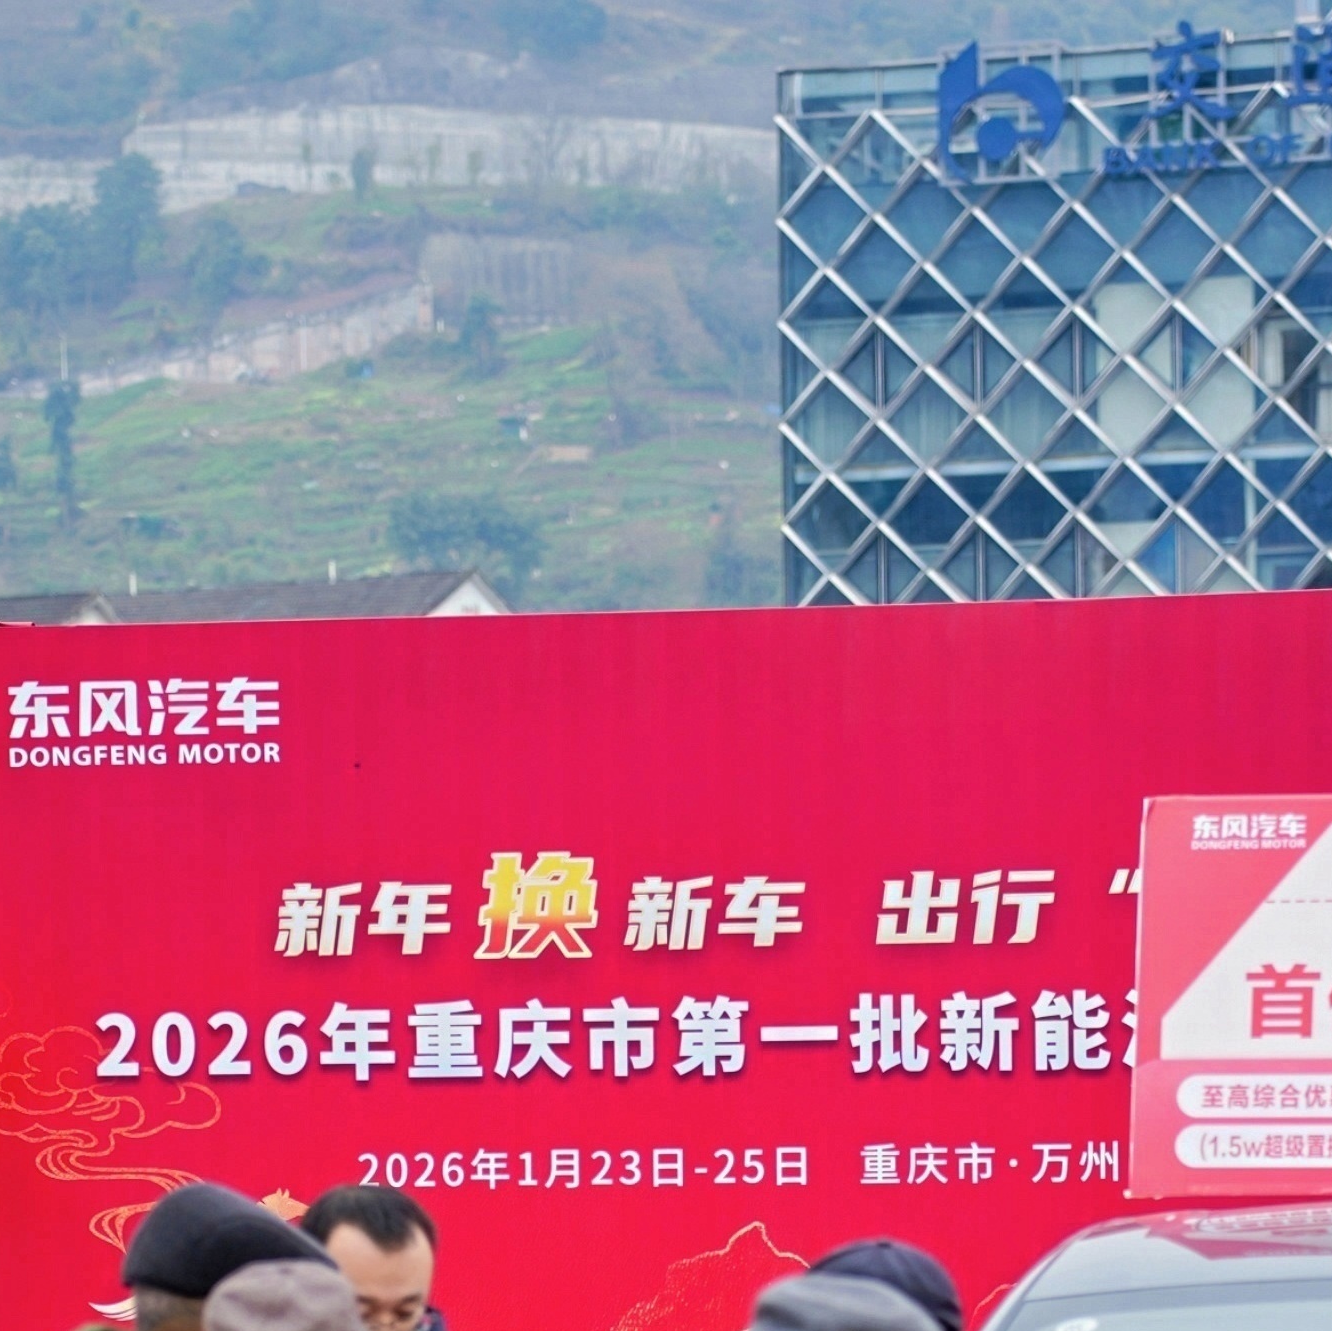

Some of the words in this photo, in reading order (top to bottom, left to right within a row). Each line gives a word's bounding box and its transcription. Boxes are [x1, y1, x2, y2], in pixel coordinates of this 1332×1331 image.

[1103, 145, 1219, 174] BANK
[1250, 132, 1303, 161] OF
[7, 676, 280, 737] 东风汽车
[8, 744, 167, 768] DONGFENG
[178, 742, 280, 764] MOTOR
[1191, 839, 1259, 850] DONGFENG
[1261, 838, 1307, 849] MOTOR
[1192, 813, 1307, 839] 东风汽车
[95, 988, 1138, 1081] 2026年重庆市第一批新能
[358, 1146, 808, 1189] 2026年1月23日-25日
